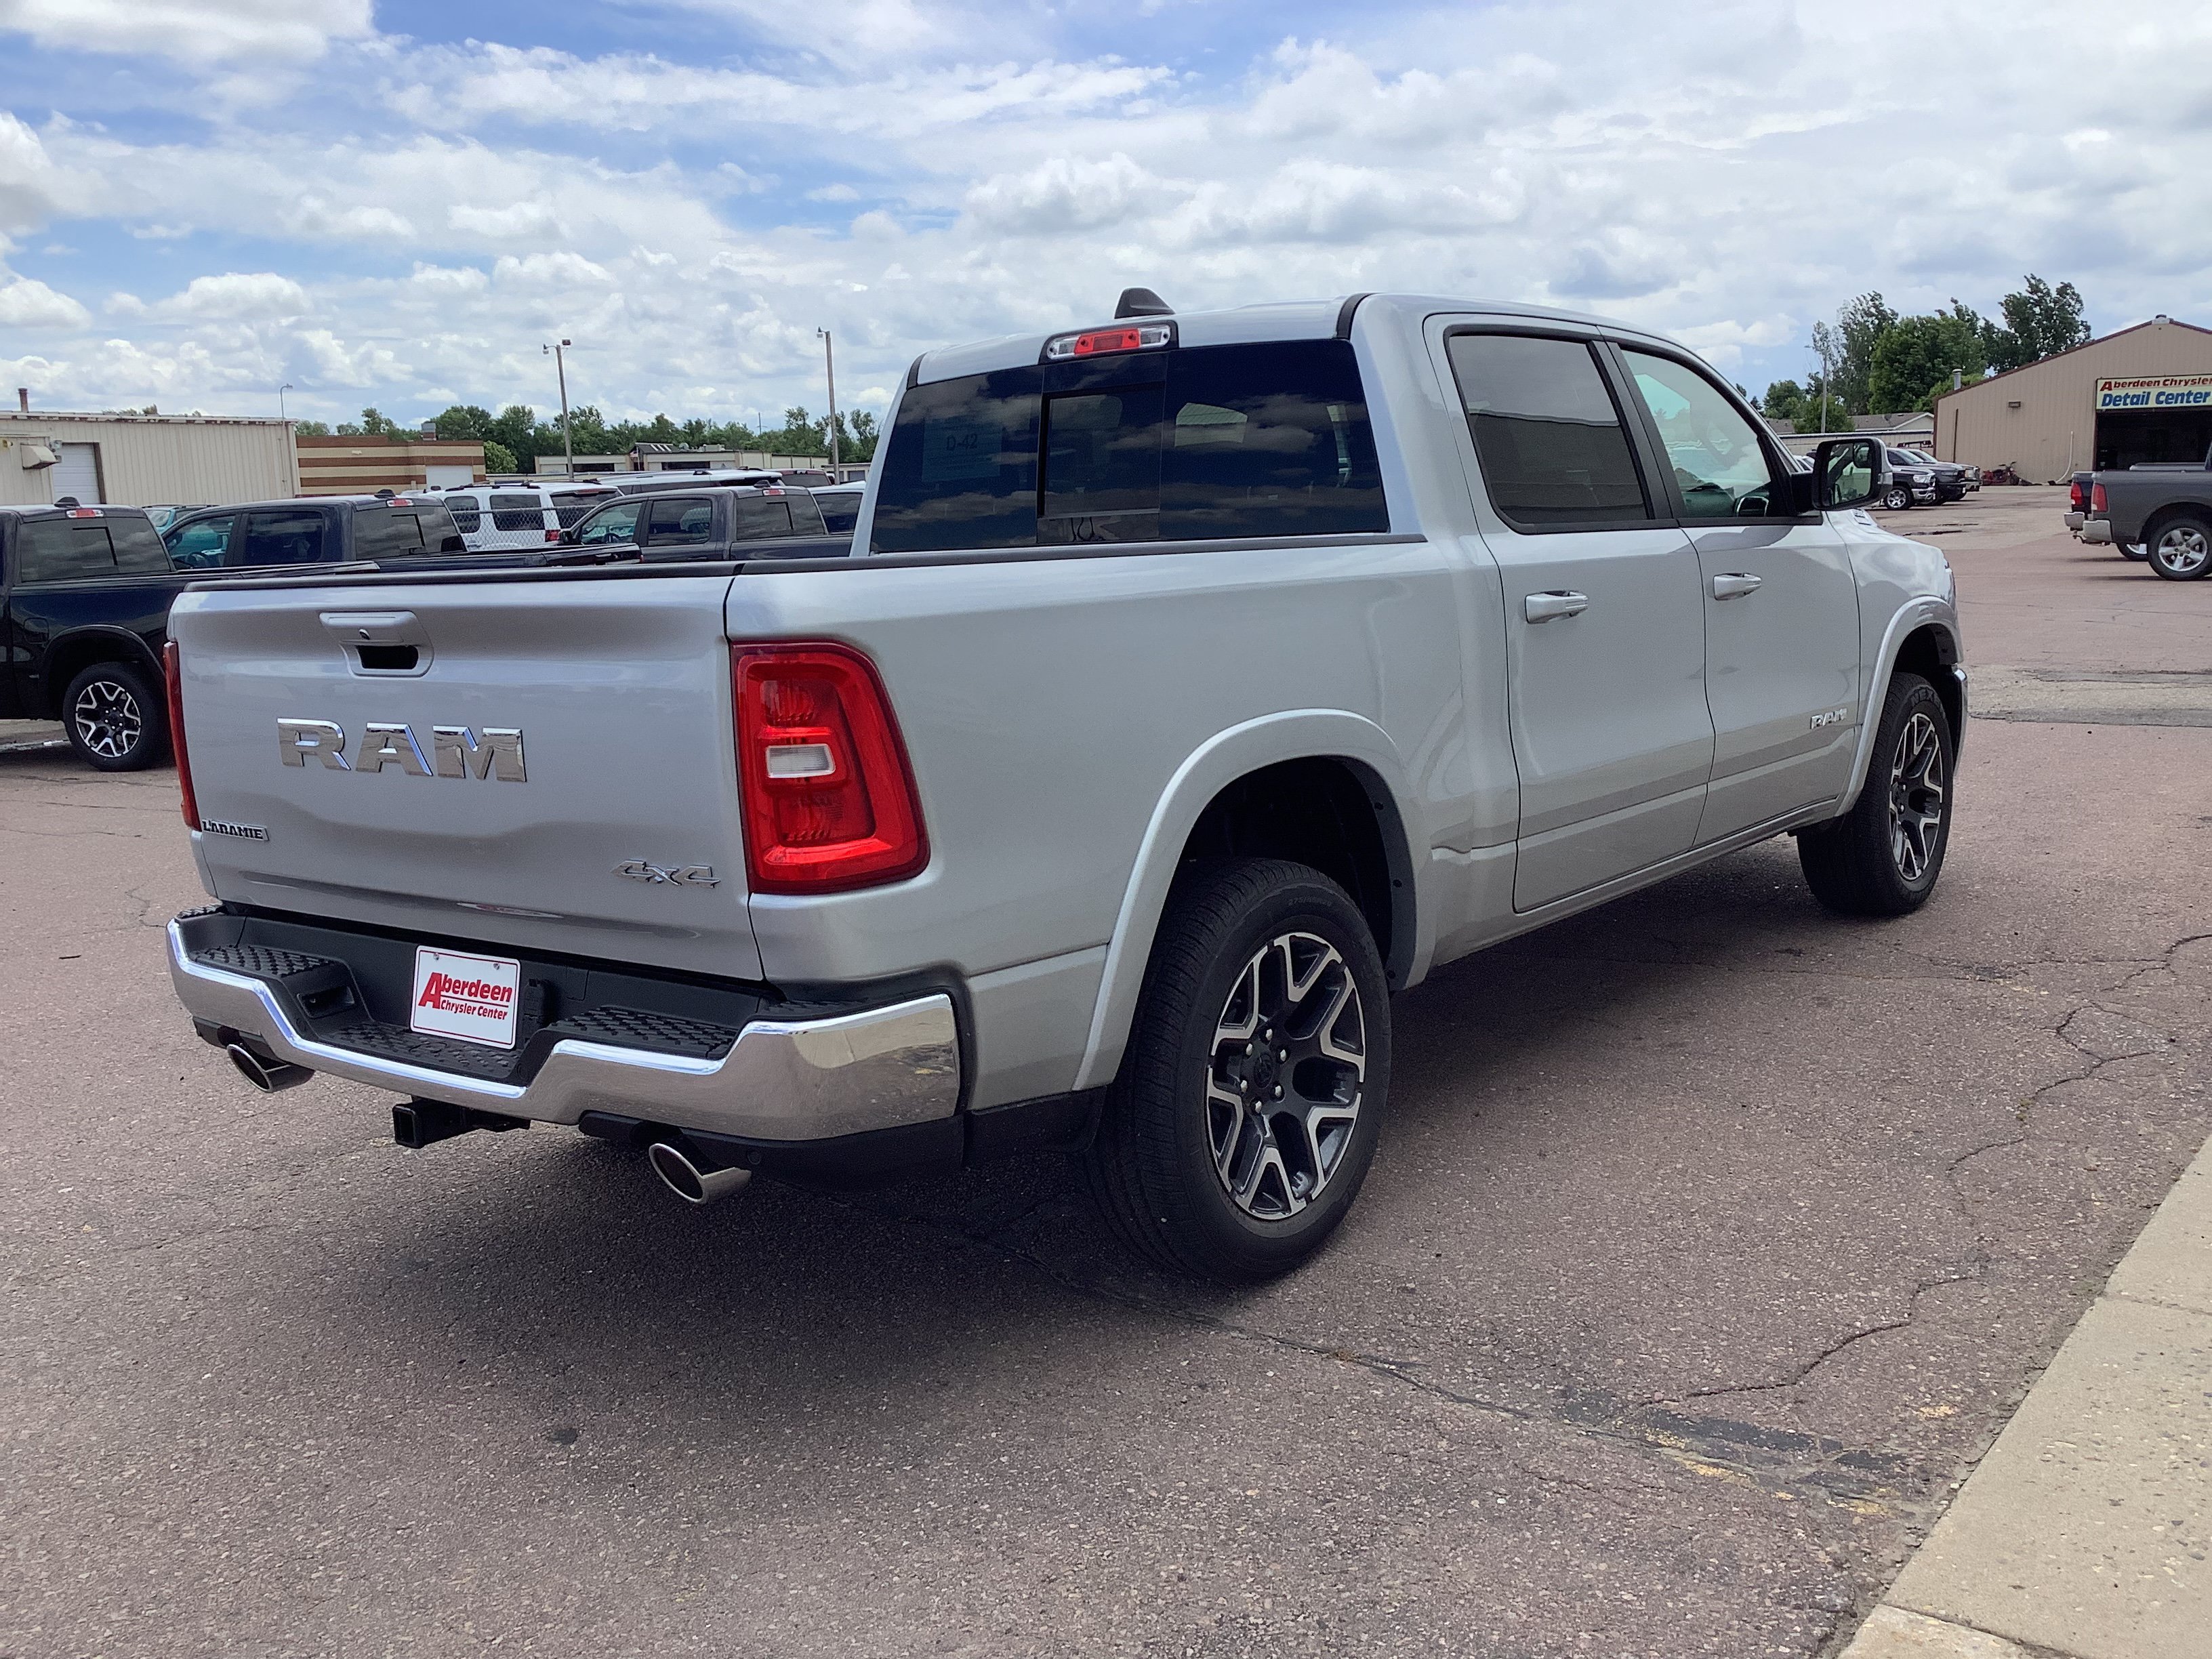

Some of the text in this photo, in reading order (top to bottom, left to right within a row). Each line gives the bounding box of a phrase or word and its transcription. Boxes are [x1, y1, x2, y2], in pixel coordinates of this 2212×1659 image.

[2100, 380, 2160, 391] Aberdeen
[2102, 390, 2211, 407] Detail Center
[946, 433, 978, 451] D-42
[1810, 708, 1847, 729] RAM
[276, 718, 527, 782] RAM
[201, 817, 264, 840] LARAMIE
[418, 972, 512, 1009] Aberdeen
[441, 1000, 508, 1020] Chrysler Center
